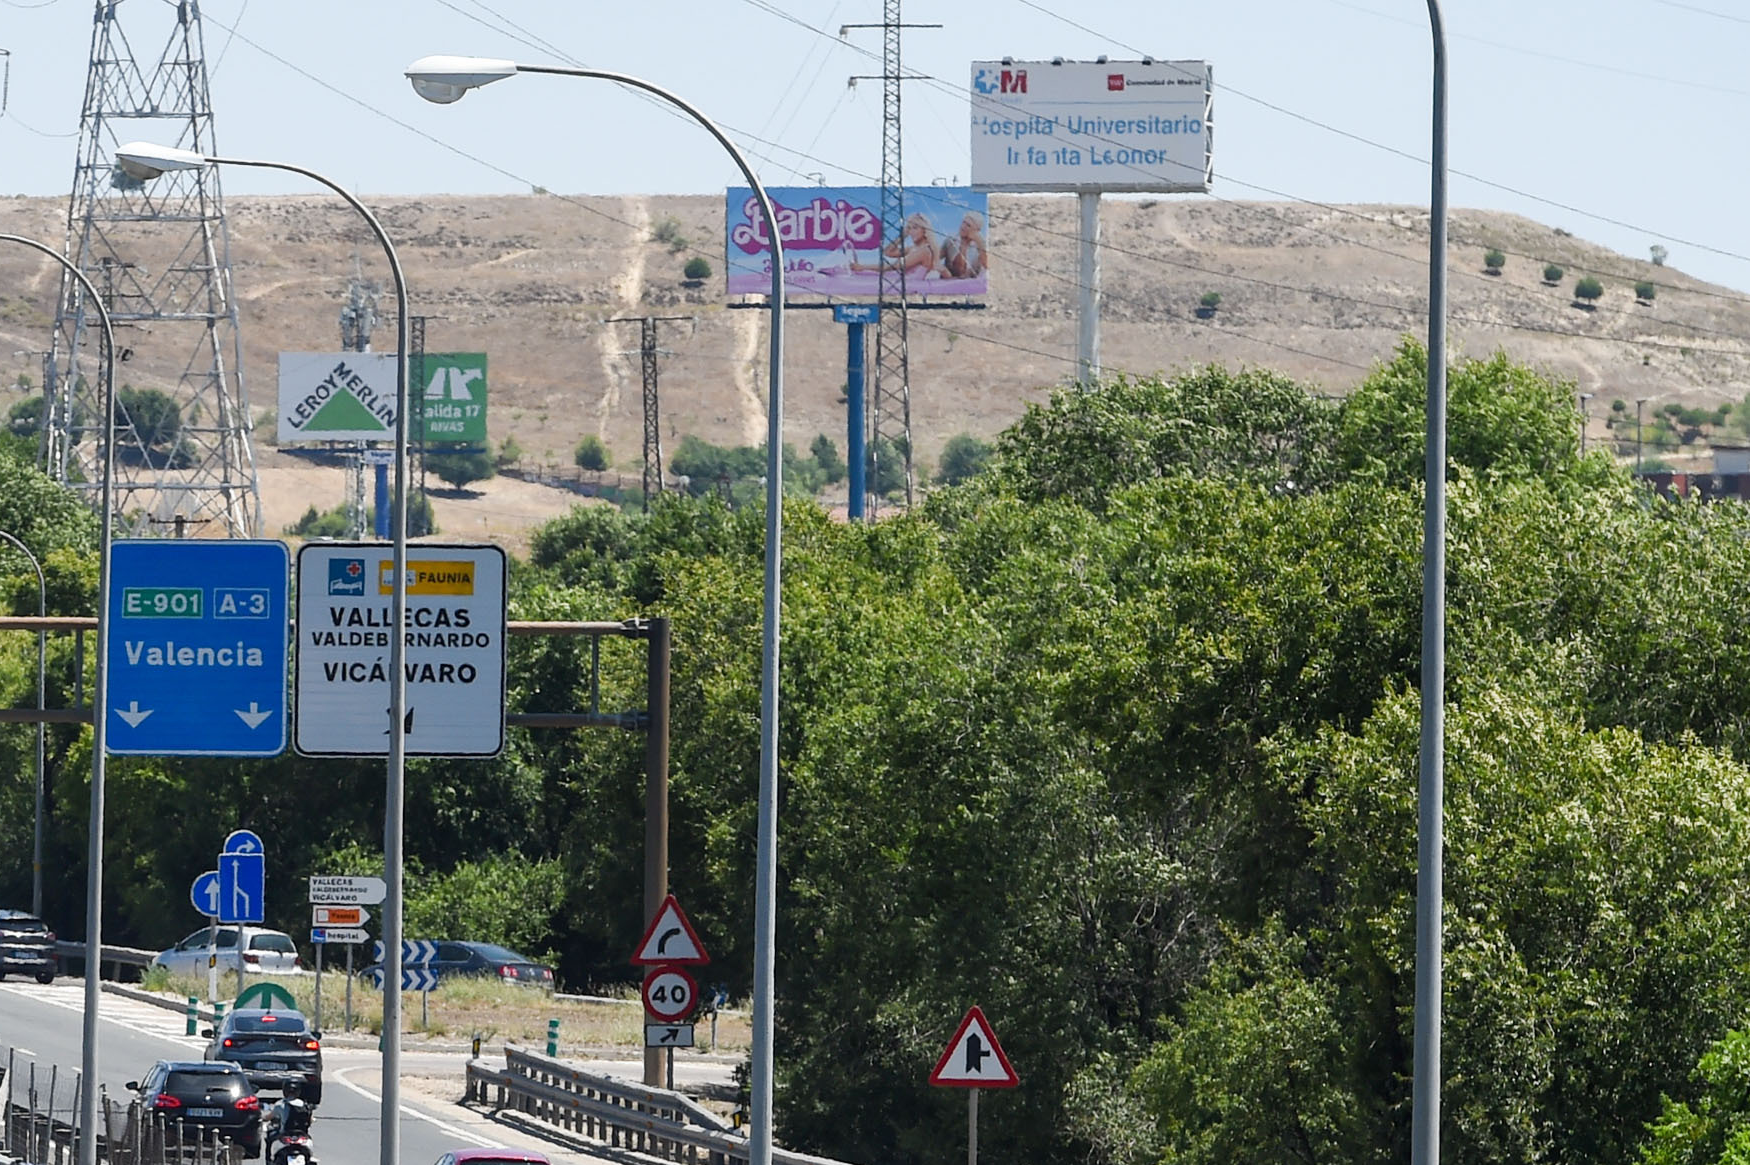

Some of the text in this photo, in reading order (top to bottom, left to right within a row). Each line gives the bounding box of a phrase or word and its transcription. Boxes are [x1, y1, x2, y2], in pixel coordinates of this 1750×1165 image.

[1067, 115, 1201, 135] Universitario
[733, 198, 874, 244] Barbie
[287, 361, 397, 429] LEROY MERLIN
[415, 404, 480, 419] alida 17
[419, 572, 471, 584] FAUNIA
[127, 593, 265, 614] E-901 A-3
[312, 632, 490, 648] VALDEBRNARDO
[125, 641, 264, 667] Valencia
[323, 657, 477, 684] VICÁVARO
[312, 878, 353, 886] VALLECAS
[652, 985, 686, 1003] 40
